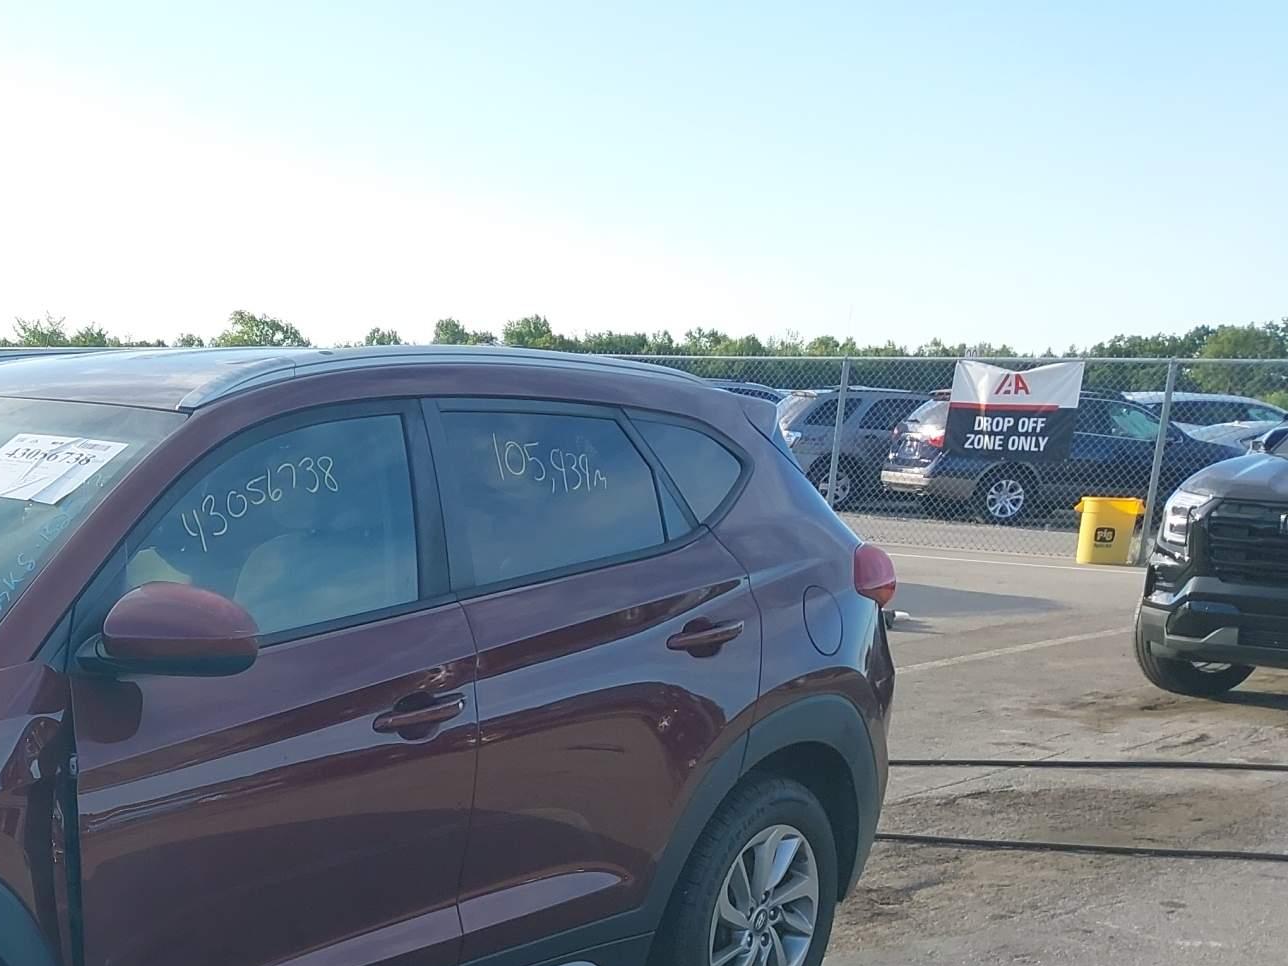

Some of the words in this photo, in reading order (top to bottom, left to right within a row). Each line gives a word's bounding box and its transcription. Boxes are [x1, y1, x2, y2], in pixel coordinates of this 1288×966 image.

[974, 416, 1014, 432] DROP
[1018, 417, 1046, 433] OFF
[964, 434, 1004, 450] ZONE
[1008, 436, 1049, 451] ONLY
[6, 447, 97, 466] 43056738
[181, 456, 339, 552] 43056738
